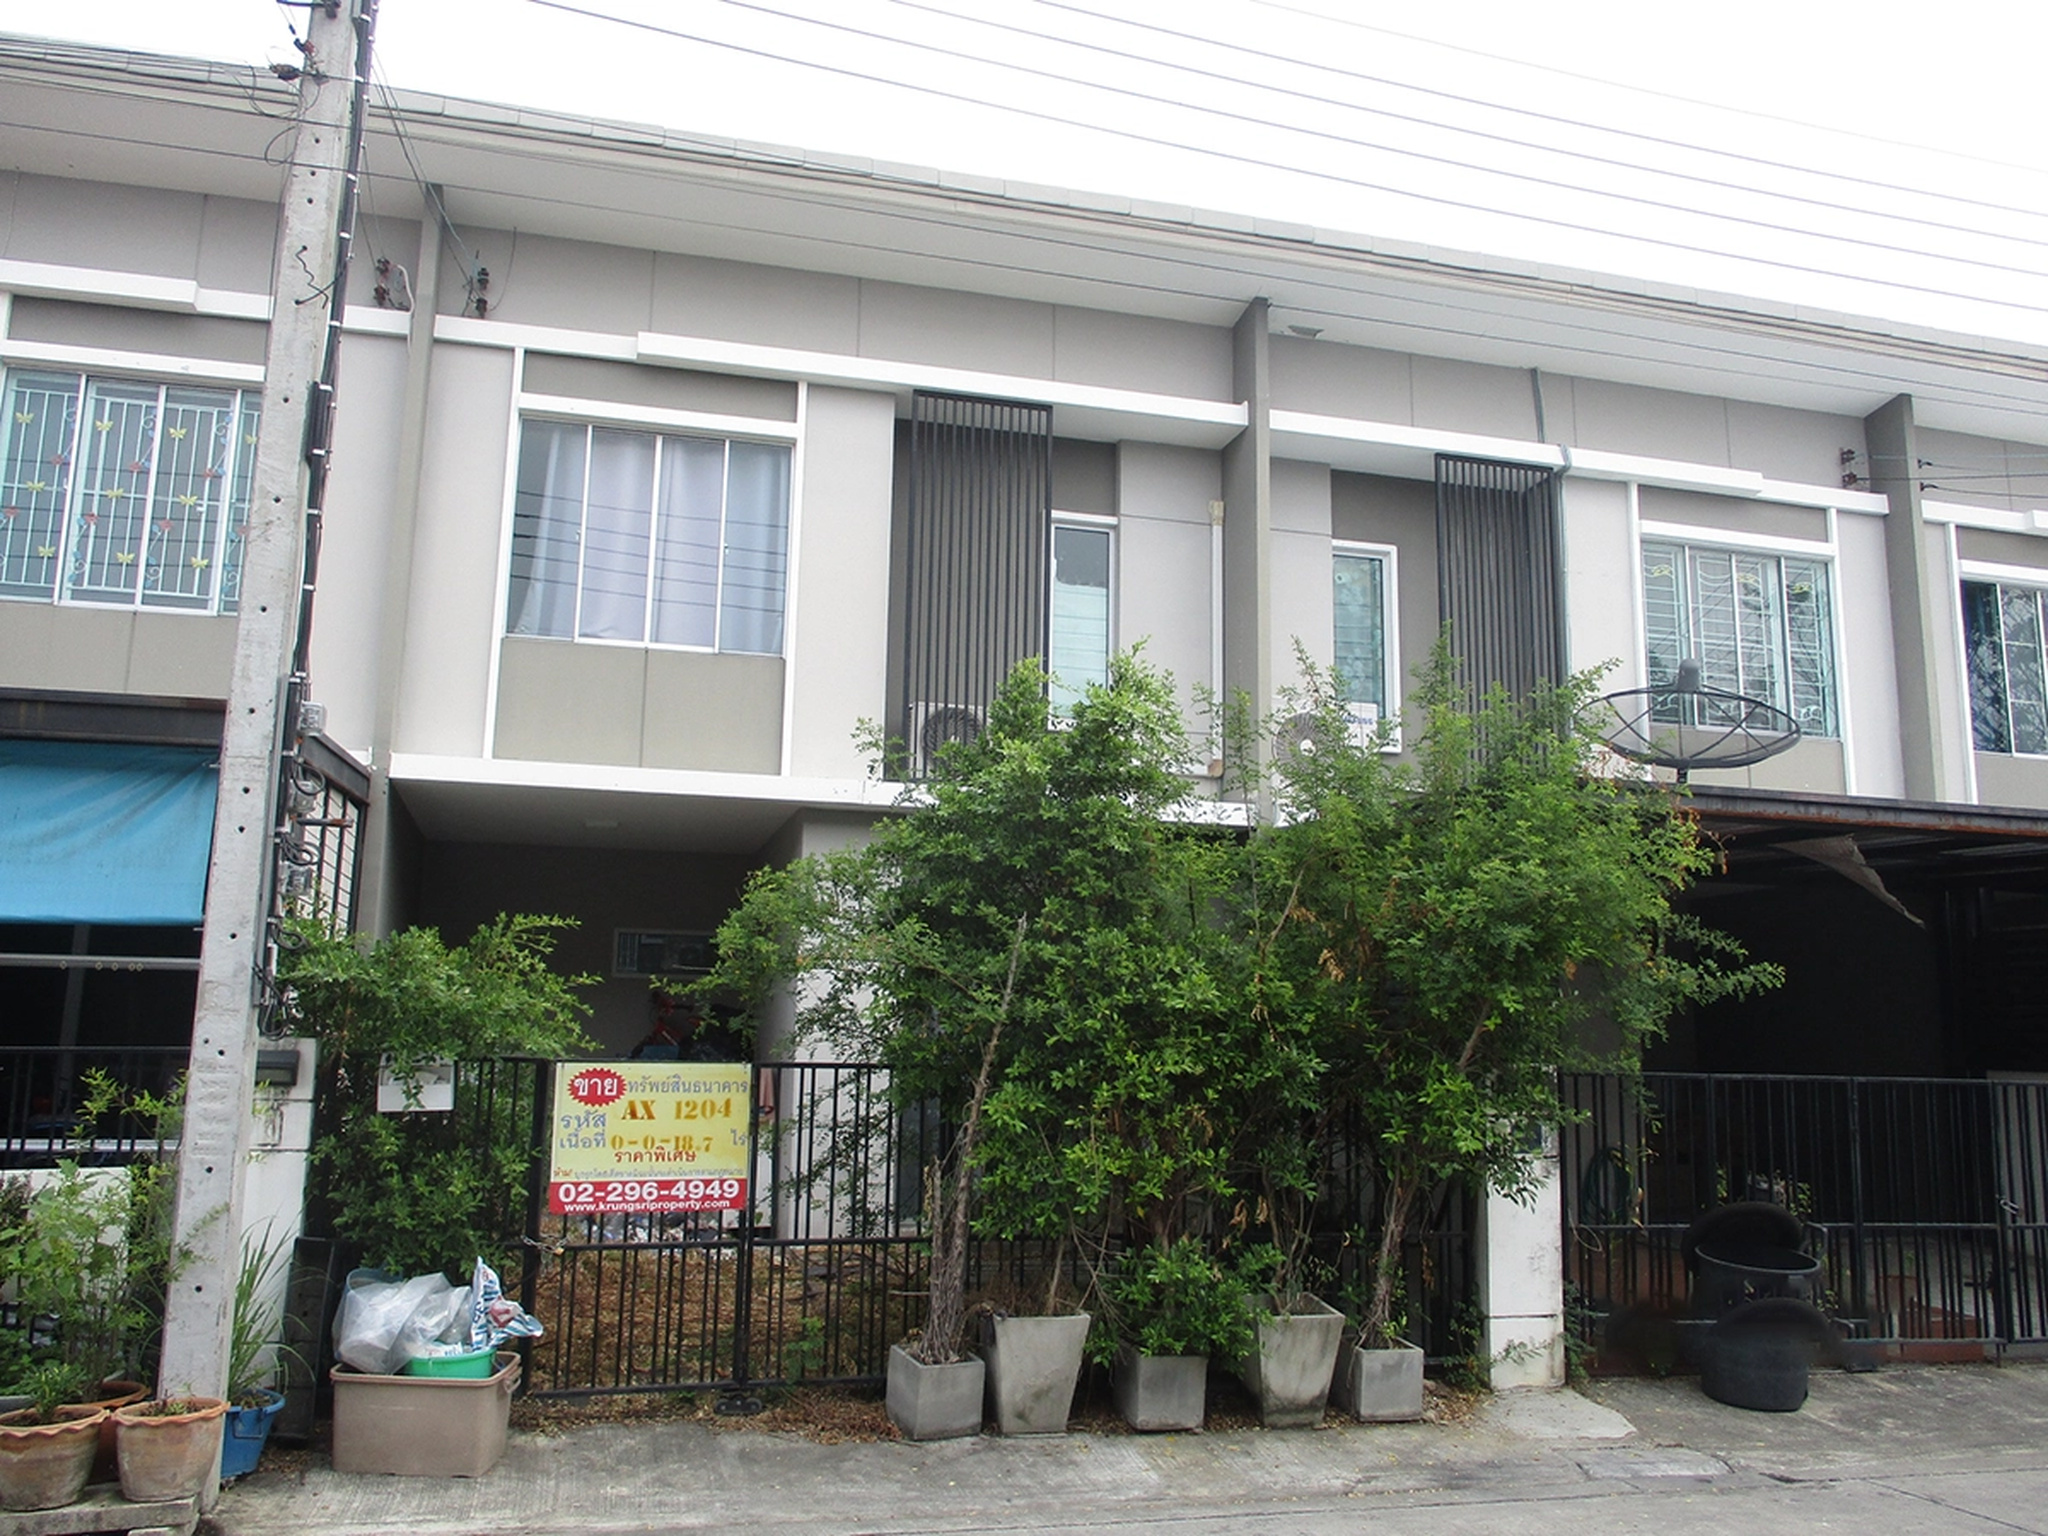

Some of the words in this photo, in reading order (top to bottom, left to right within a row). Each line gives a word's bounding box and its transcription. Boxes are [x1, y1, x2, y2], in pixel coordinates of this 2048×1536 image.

[573, 1077, 618, 1096] ขาย
[627, 1073, 748, 1094] ทรัพย์สินธนาคาร
[621, 1099, 656, 1120] AX
[674, 1097, 732, 1120] 1204
[560, 1109, 607, 1129] รหัส
[614, 1144, 697, 1163] ราคาพิเศษ
[558, 1179, 740, 1203] 02-296-4949
[564, 1199, 731, 1214] www.krungsriproperty.com
